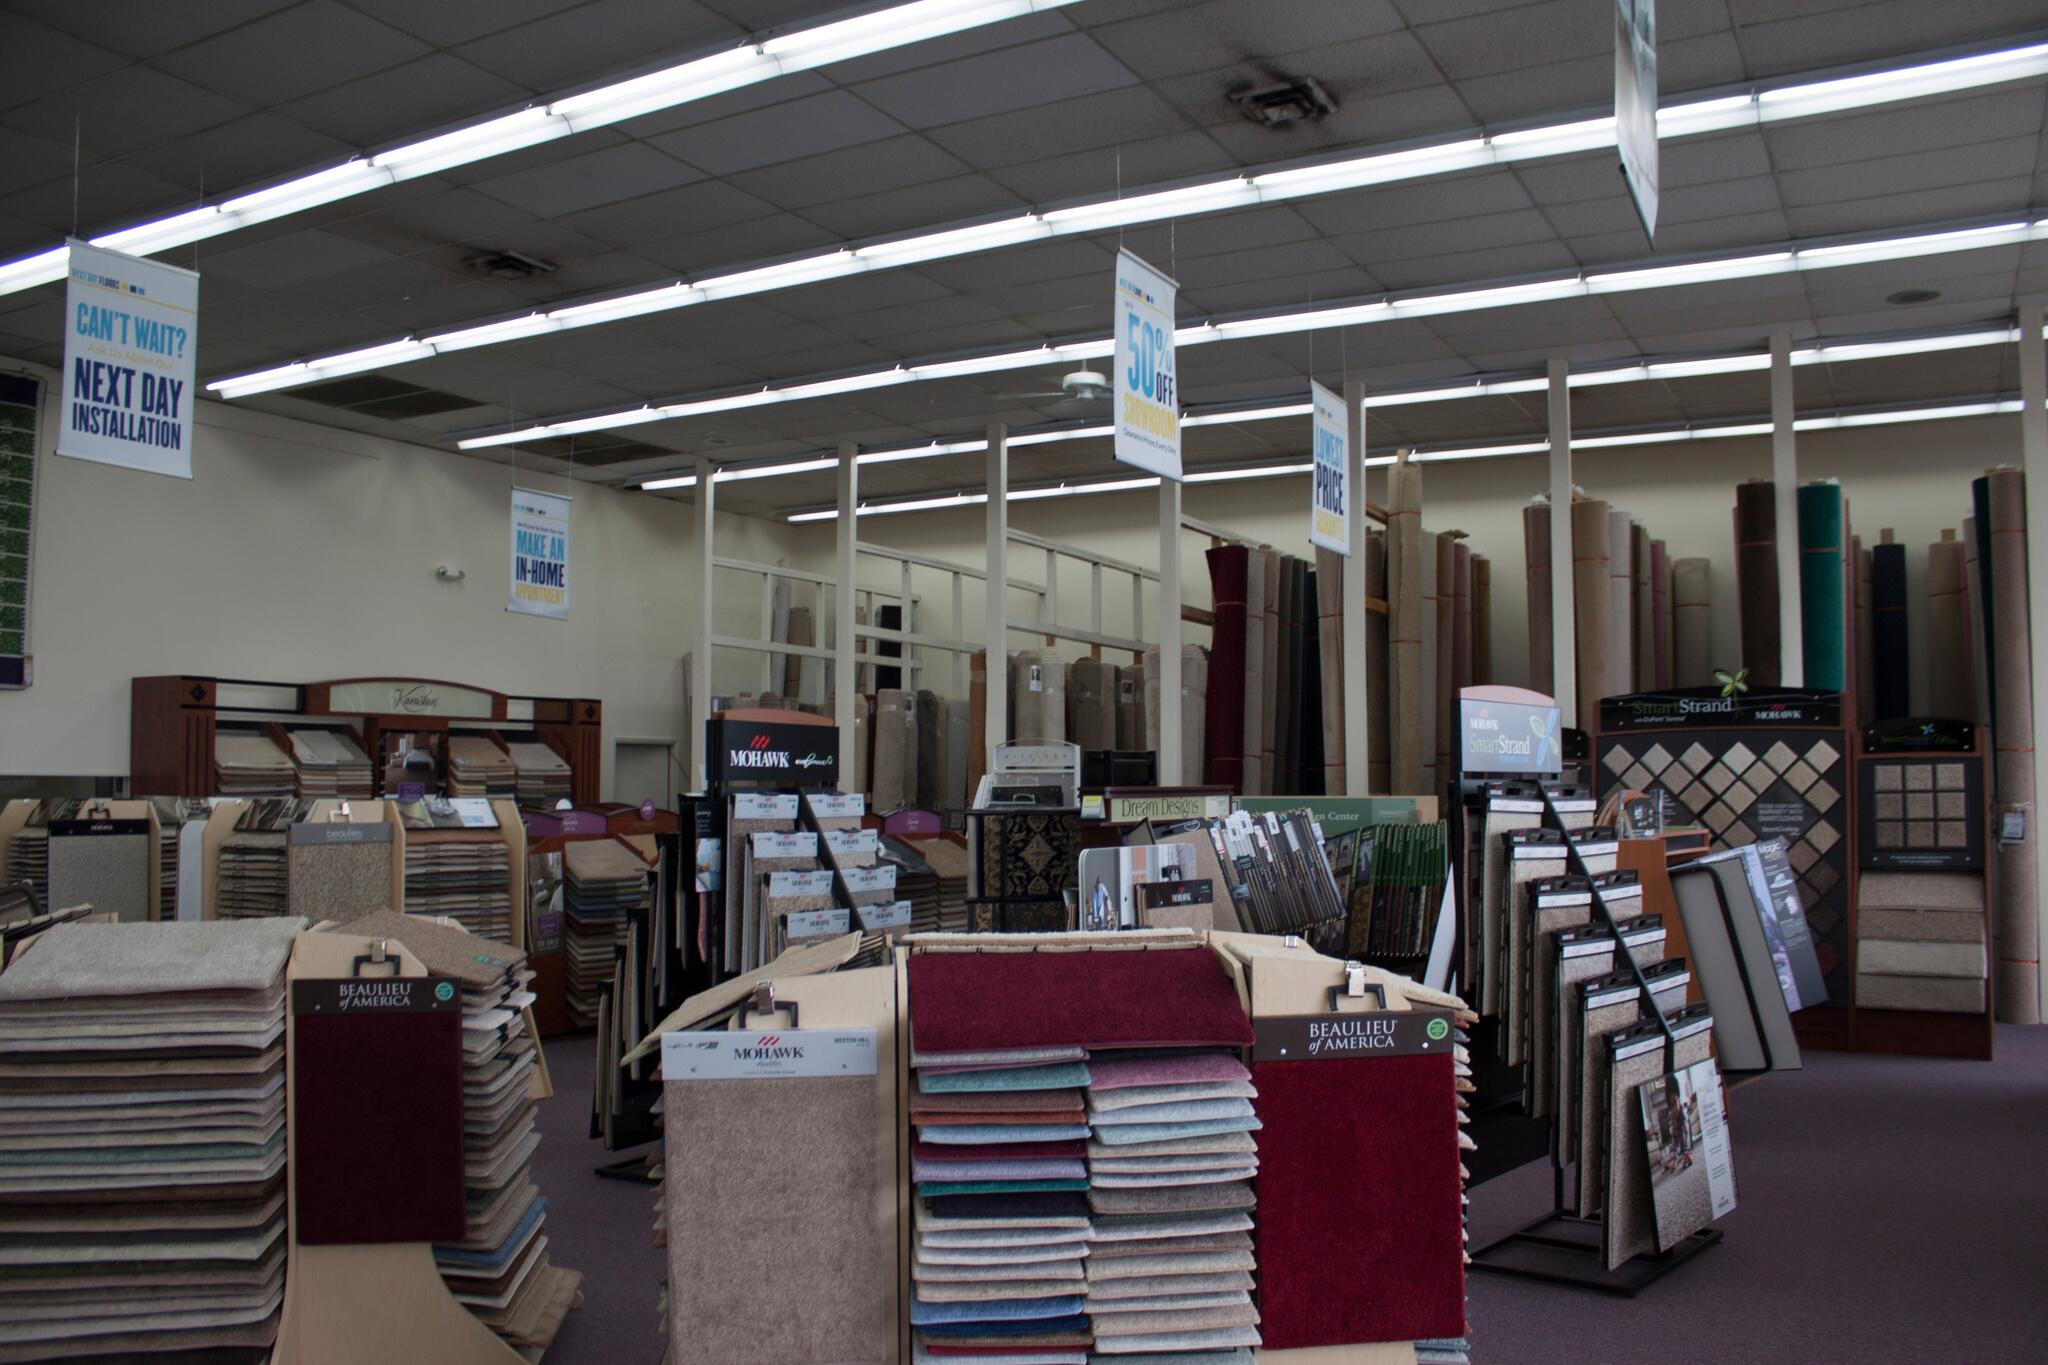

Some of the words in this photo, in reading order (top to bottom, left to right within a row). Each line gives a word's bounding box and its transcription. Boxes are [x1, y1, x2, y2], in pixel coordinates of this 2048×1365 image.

[76, 302, 130, 345] CAN'T
[134, 315, 188, 359] WAIT?
[74, 357, 136, 409] NEXT
[141, 371, 183, 419] DAY
[1156, 371, 1173, 407] OFF
[72, 402, 181, 450] INSTALLATION
[1123, 391, 1176, 442] SHOWROOM
[1316, 461, 1344, 516] PRICE
[516, 529, 546, 558] MAKE
[549, 536, 565, 562] AN
[516, 556, 565, 588] IN-HOME
[1754, 710, 1802, 720] MOHAWK
[730, 750, 789, 769] MOHAWK
[1121, 799, 1158, 817] Dream
[1161, 798, 1199, 817] Designs
[1327, 811, 1360, 822] Center
[339, 982, 412, 997] BEAULIEU
[338, 996, 350, 1011] of
[352, 995, 412, 1008] AMERICA
[1308, 1019, 1397, 1038] BEAULIEU
[733, 1046, 804, 1060] MOHAWK
[1308, 1037, 1323, 1055] of
[1324, 1036, 1396, 1051] AMERICA
